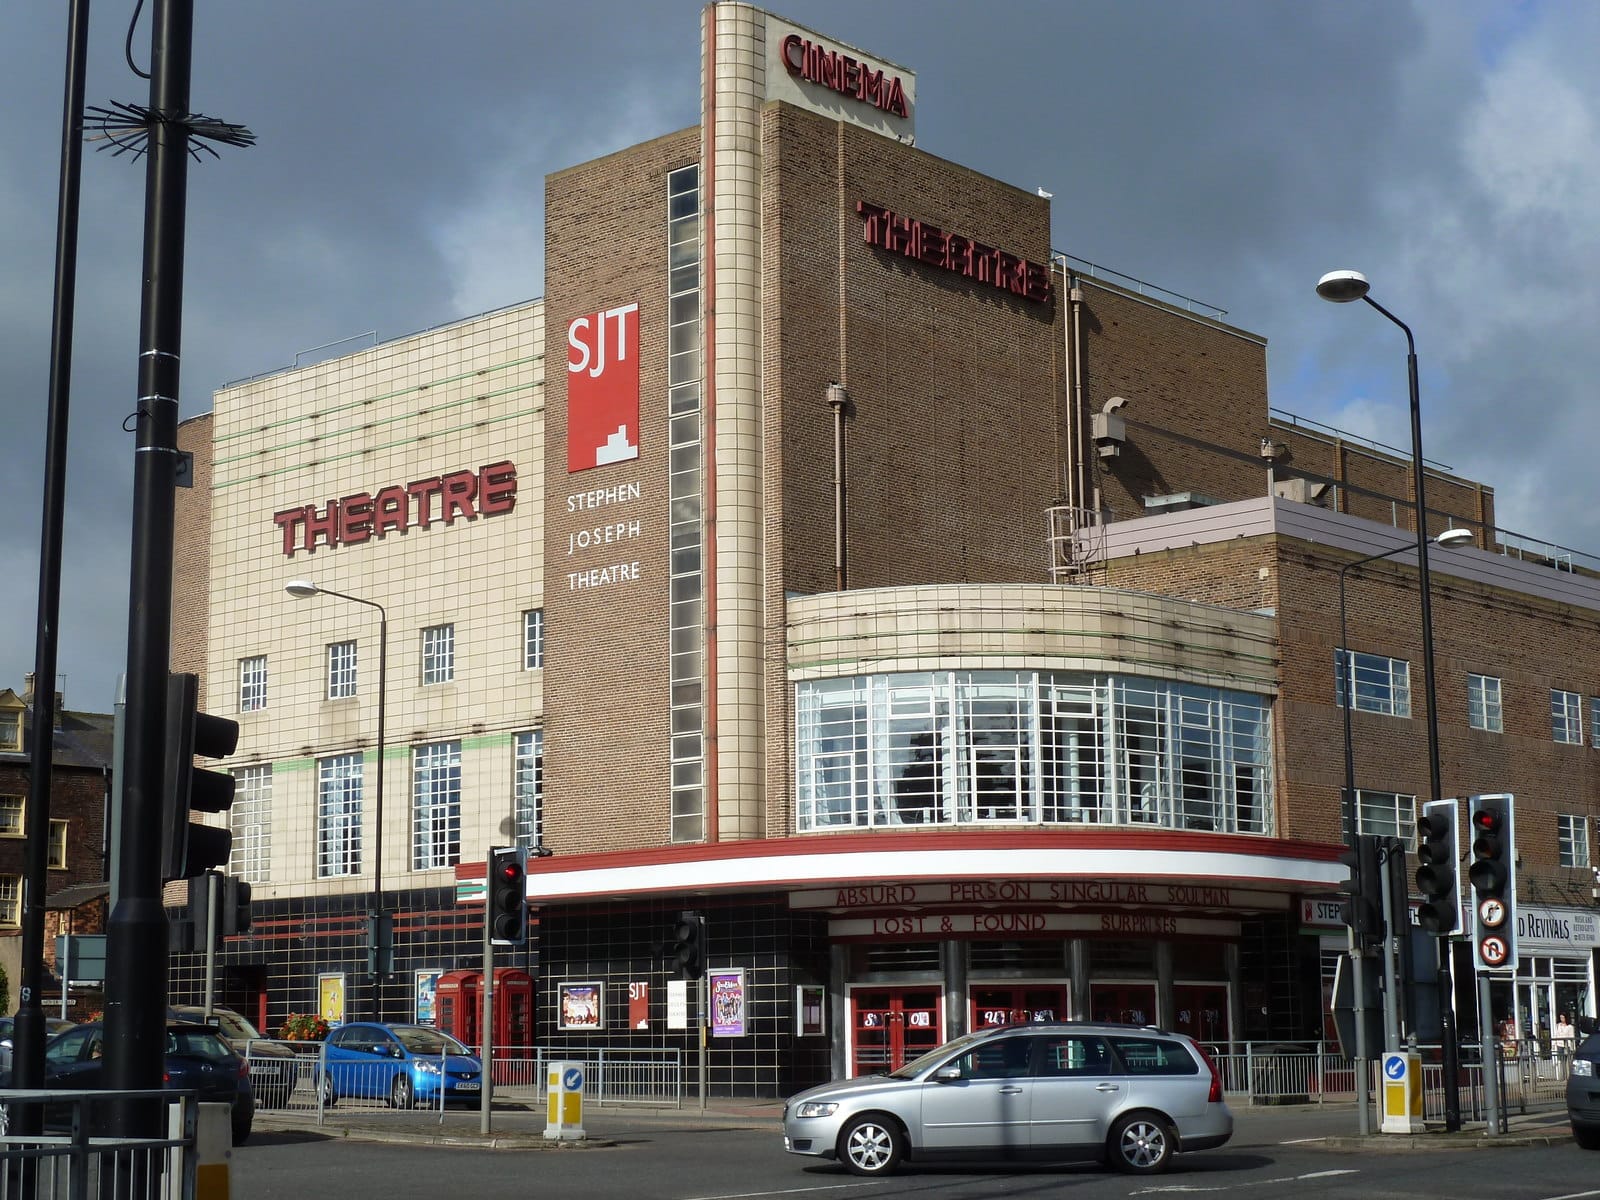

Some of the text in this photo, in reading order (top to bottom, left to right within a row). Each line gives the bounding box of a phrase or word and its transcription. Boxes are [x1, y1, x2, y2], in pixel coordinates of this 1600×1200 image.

[779, 34, 908, 119] CINEMA
[856, 200, 1050, 302] THEATRE
[568, 302, 639, 378] SJT
[273, 460, 517, 558] THEATRE
[567, 481, 640, 512] STEPHEN
[567, 520, 640, 555] JOSEPH
[567, 562, 640, 590] THEATRE
[836, 886, 916, 906] ABSURD
[950, 882, 1031, 901] PERSON
[1050, 883, 1149, 902] SINGULAR
[873, 913, 1177, 935] LOST & FOUND SURPRISES
[1317, 902, 1341, 920] STEP
[629, 981, 648, 1000] SJT
